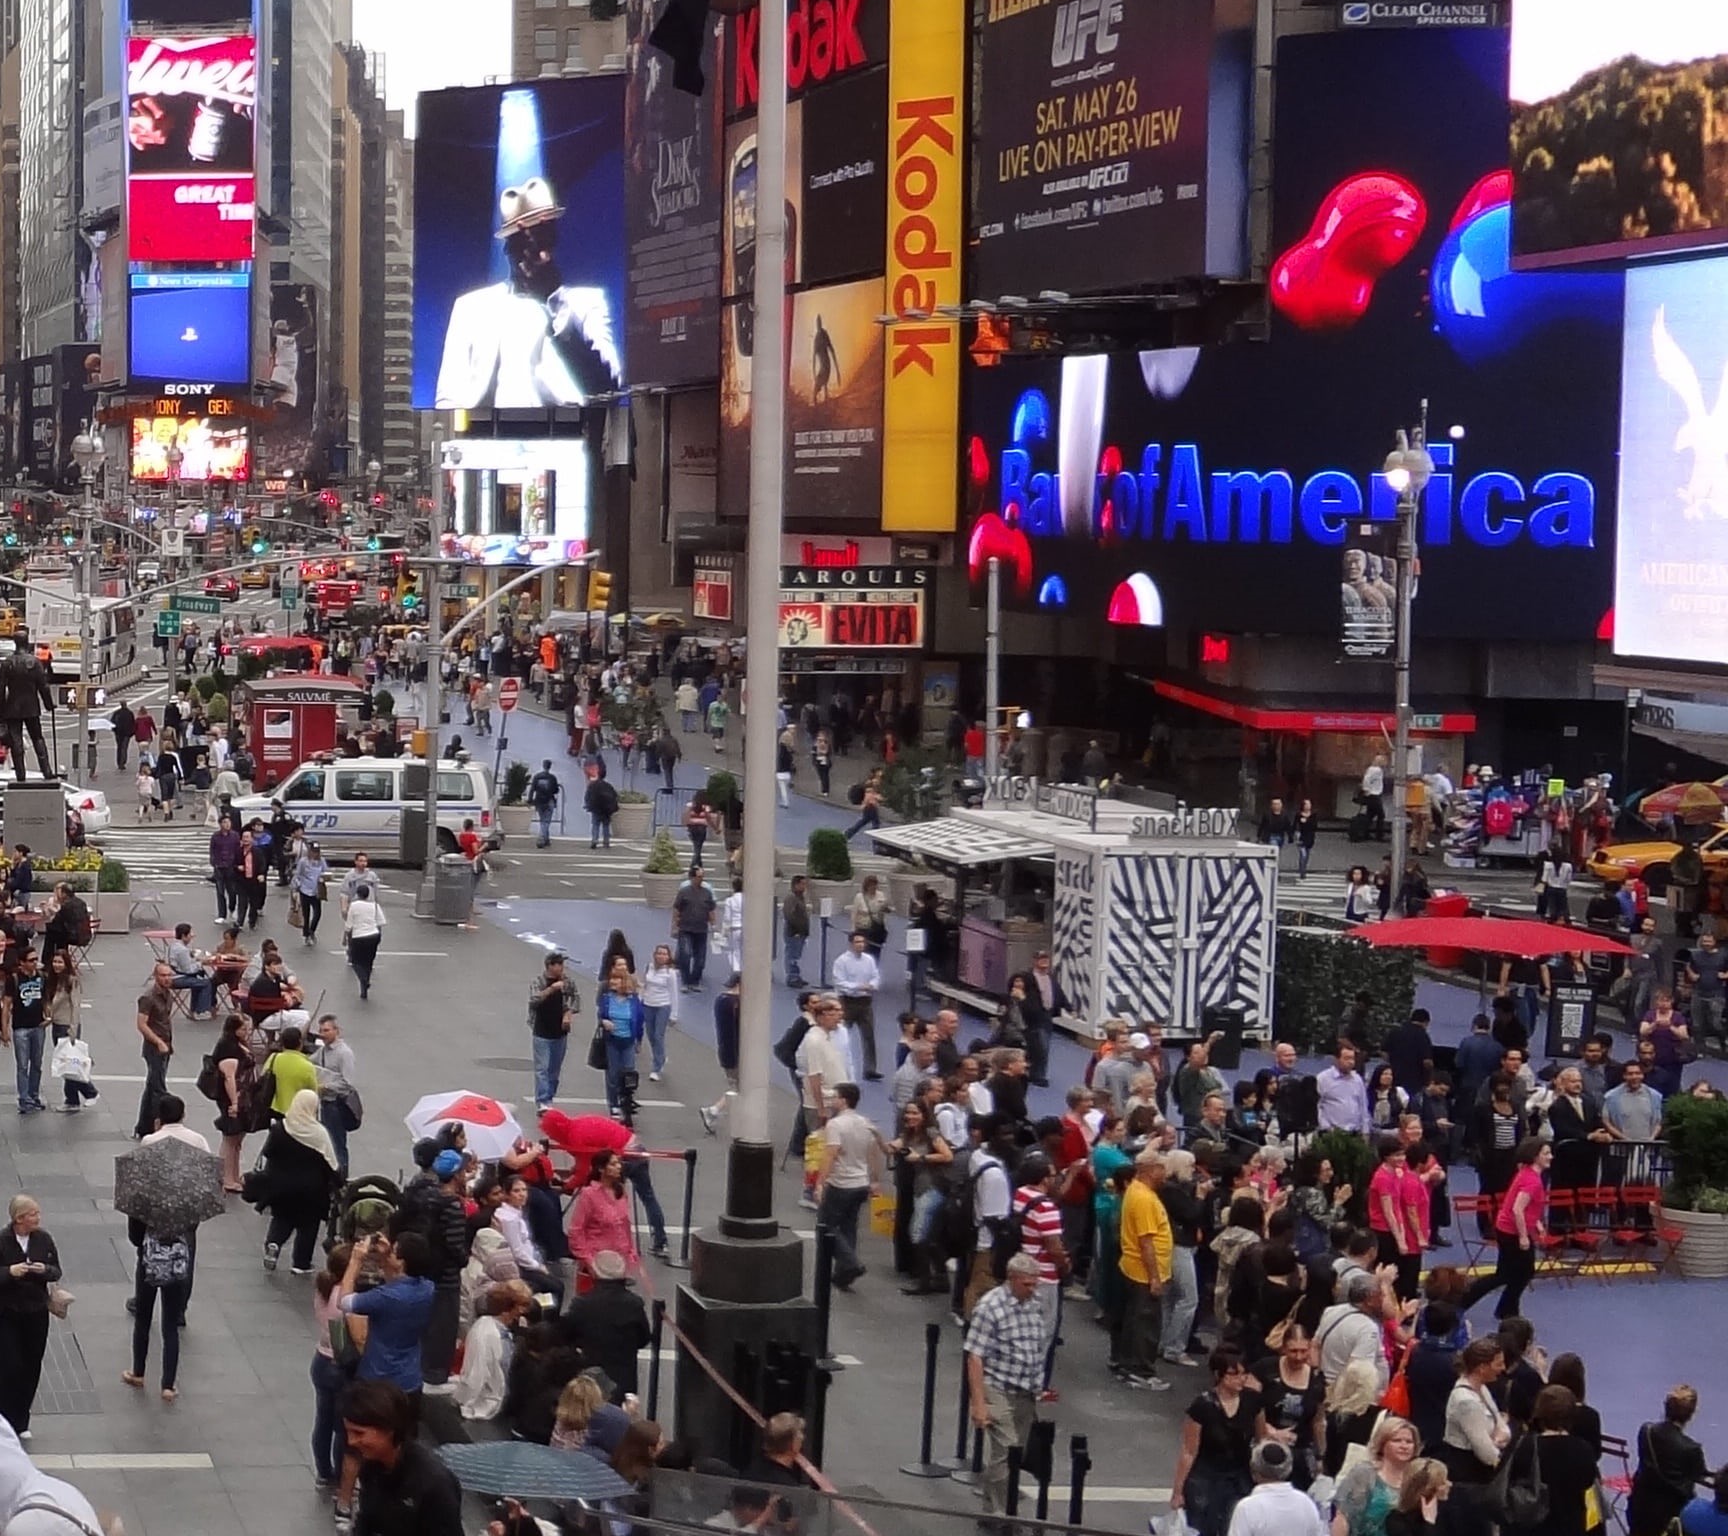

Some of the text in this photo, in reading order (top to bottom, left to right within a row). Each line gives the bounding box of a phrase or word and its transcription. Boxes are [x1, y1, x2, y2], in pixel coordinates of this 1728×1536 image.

[1035, 76, 1139, 136] SAT. MAY 26
[999, 104, 1183, 183] LIVE ON PAY-PER-VIEW
[175, 185, 237, 204] GREAT
[891, 95, 954, 379] Kodak
[183, 276, 233, 287] Corporation
[164, 383, 215, 395] SONY
[1115, 444, 1162, 541] of
[176, 598, 215, 613] Broadway
[830, 605, 918, 645] EVITA
